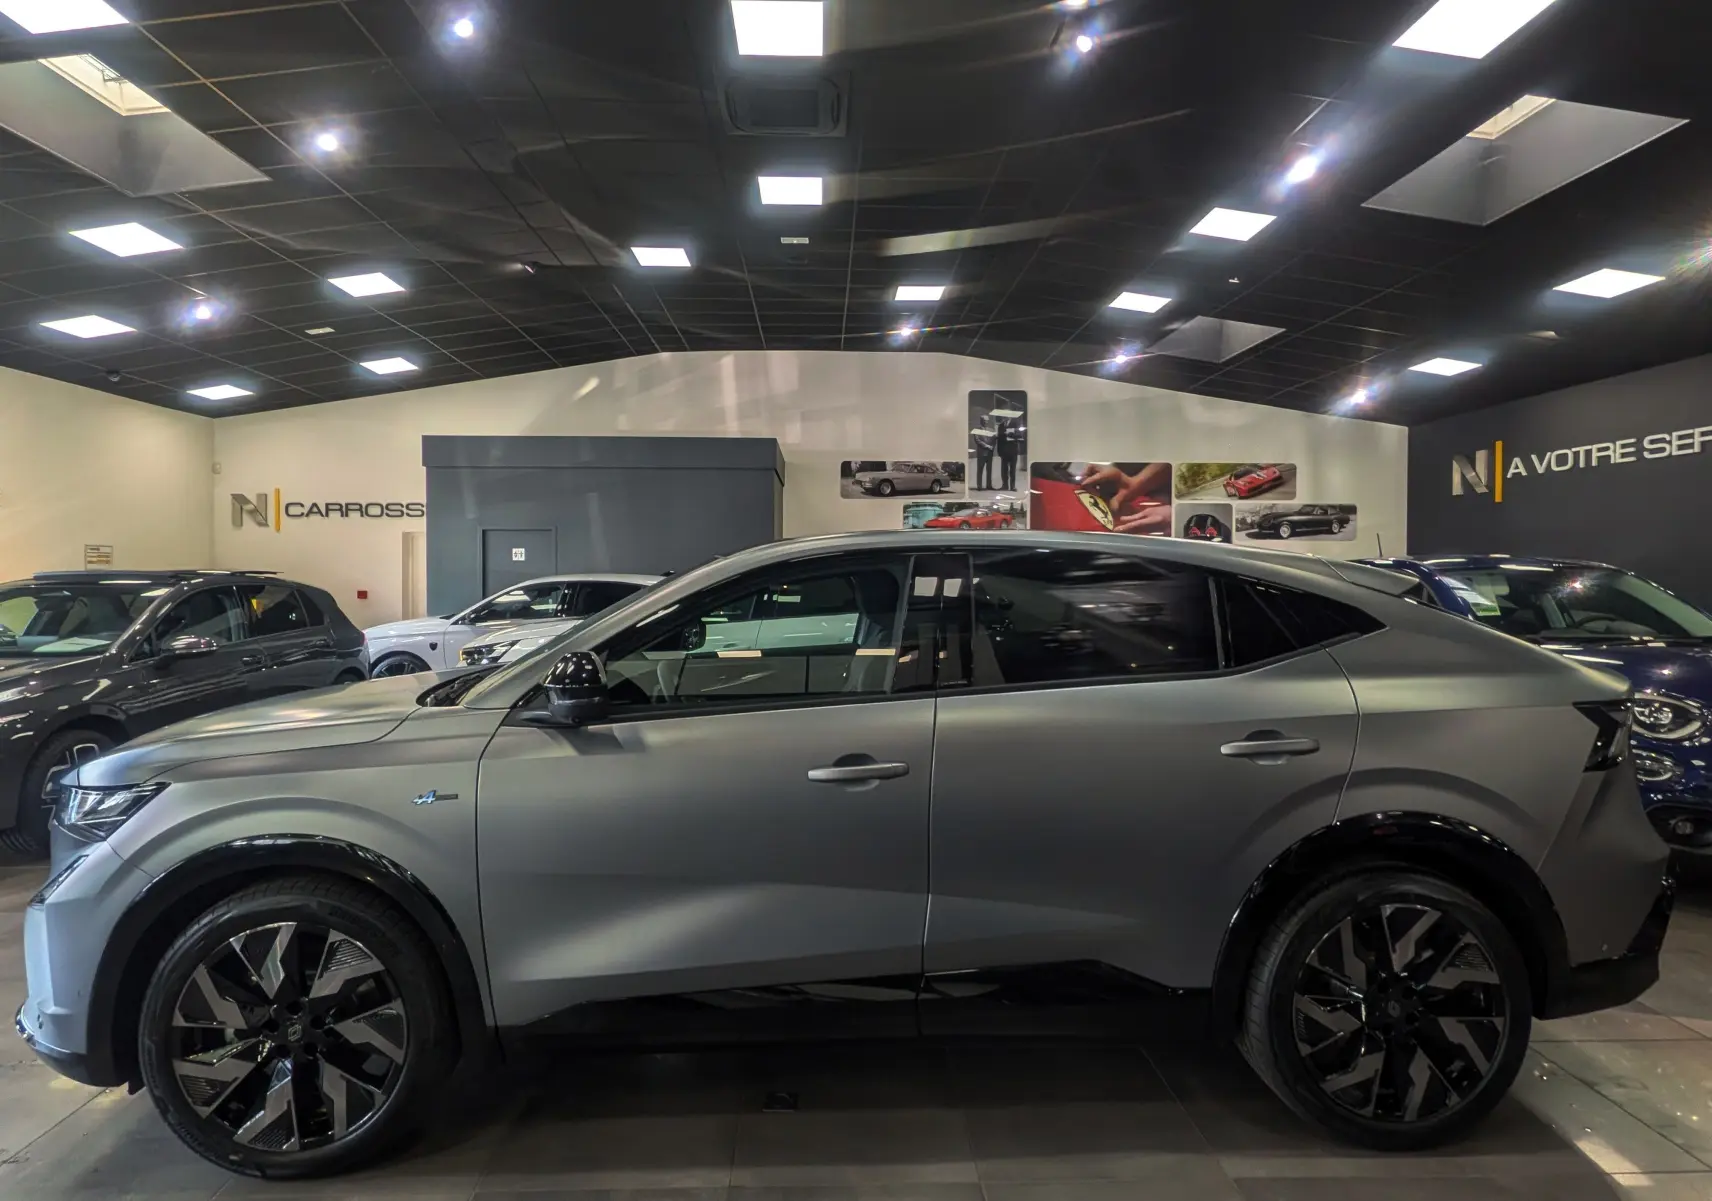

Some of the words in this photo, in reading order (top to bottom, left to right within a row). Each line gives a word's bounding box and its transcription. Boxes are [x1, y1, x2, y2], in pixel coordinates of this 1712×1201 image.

[1506, 457, 1528, 478] A
[1530, 438, 1637, 474] VOTRE
[285, 502, 425, 518] CARROSS
